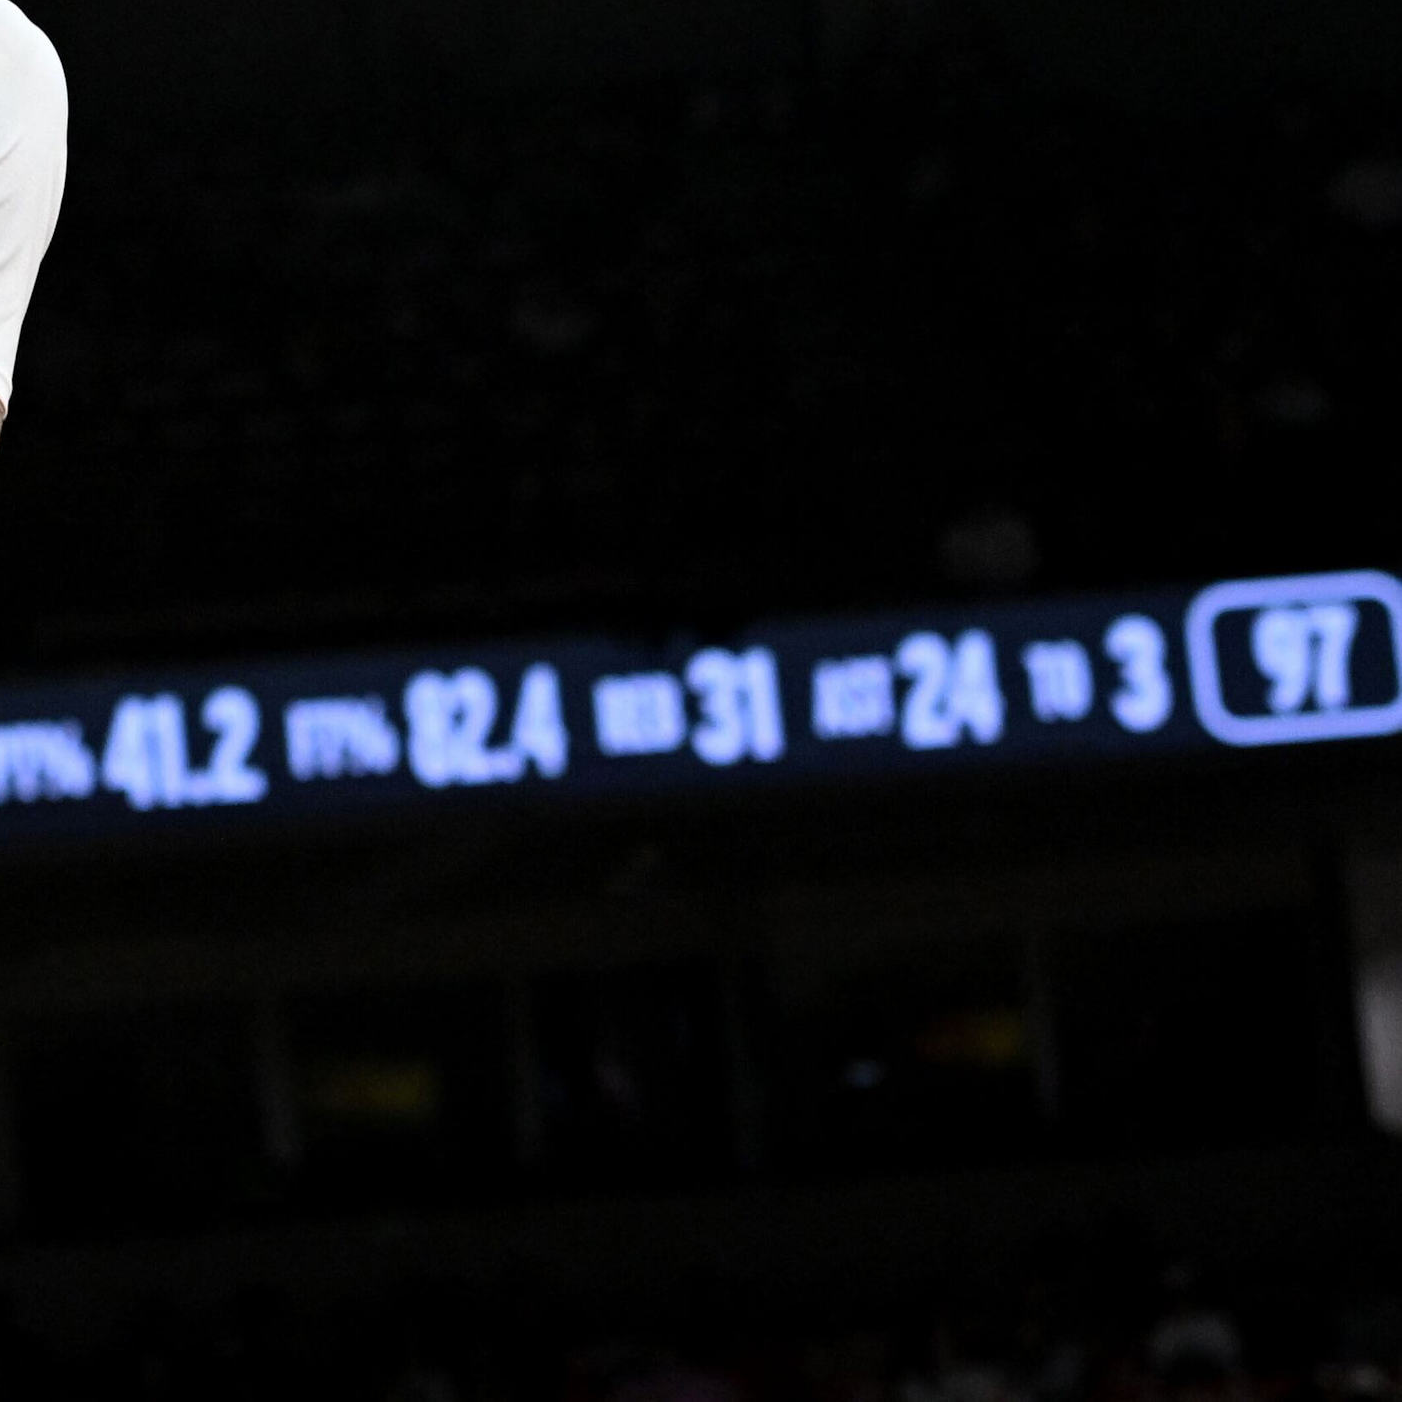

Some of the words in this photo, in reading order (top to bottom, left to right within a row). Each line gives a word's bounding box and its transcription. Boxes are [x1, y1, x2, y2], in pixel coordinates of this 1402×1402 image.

[102, 686, 269, 811] 41.2
[685, 647, 786, 766] 31
[894, 628, 1004, 751] 24
[1104, 614, 1173, 733] 3
[1253, 605, 1359, 715] 97
